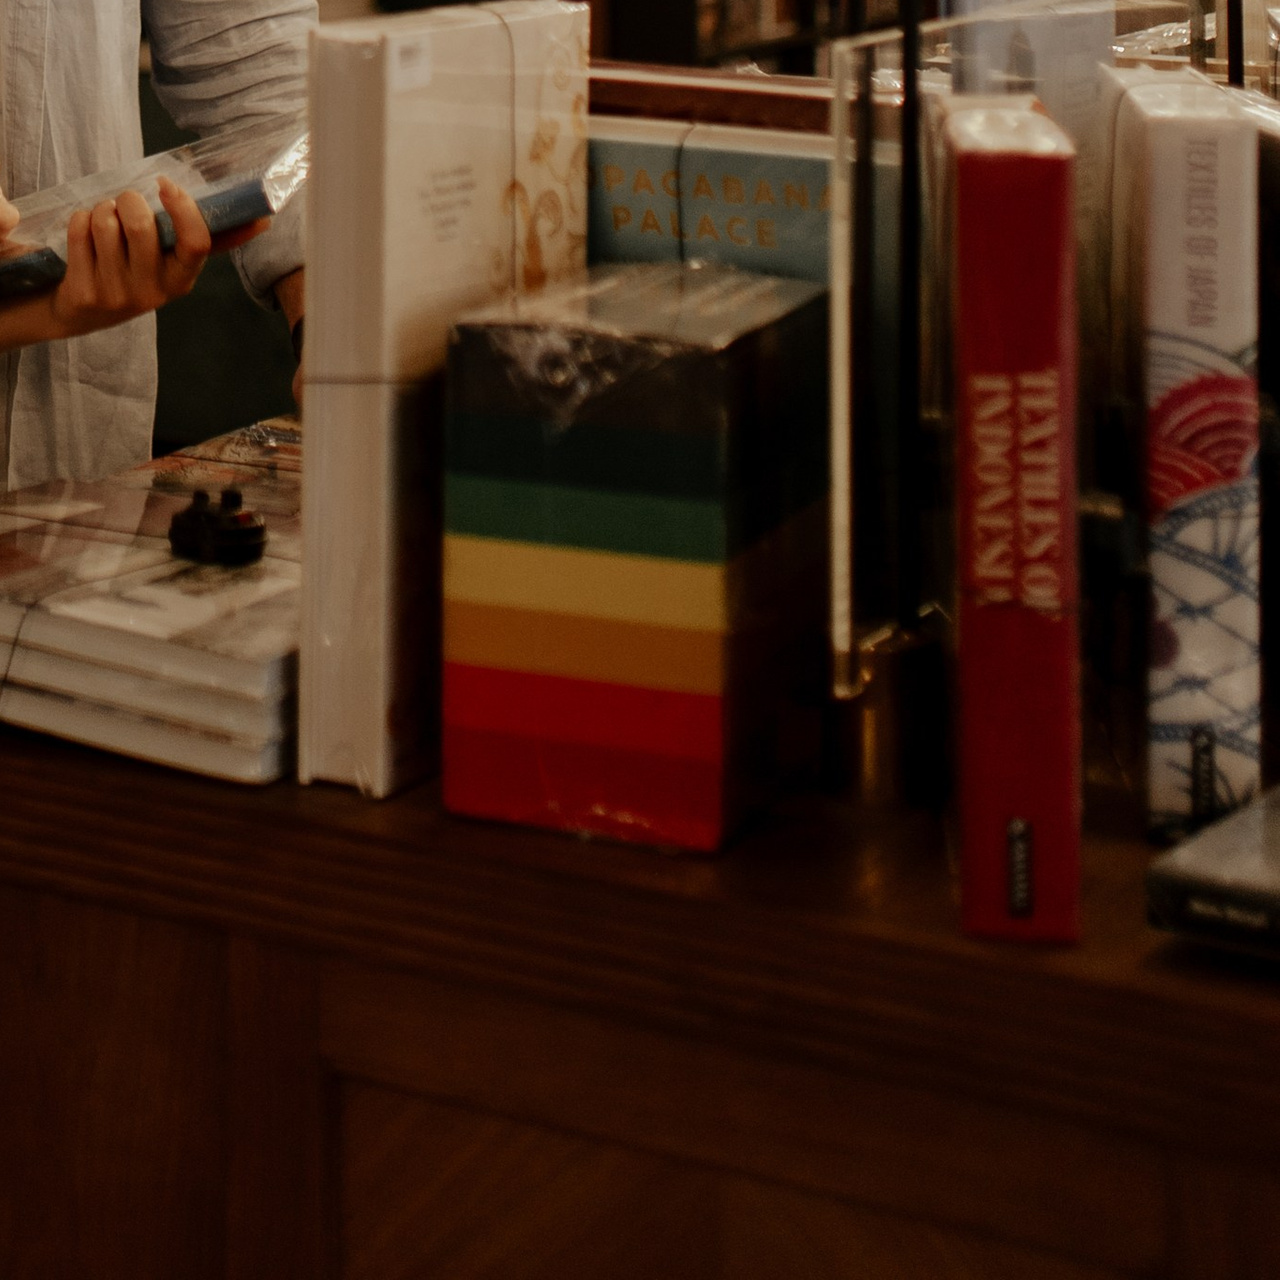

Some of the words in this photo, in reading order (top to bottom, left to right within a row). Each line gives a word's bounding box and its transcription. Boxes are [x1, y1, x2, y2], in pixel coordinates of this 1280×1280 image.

[1185, 137, 1219, 228] TEXTILES
[611, 204, 779, 249] PALACE
[1185, 236, 1219, 260] OF
[1185, 265, 1219, 328] JAPAN
[1018, 370, 1061, 558] TEXTILES
